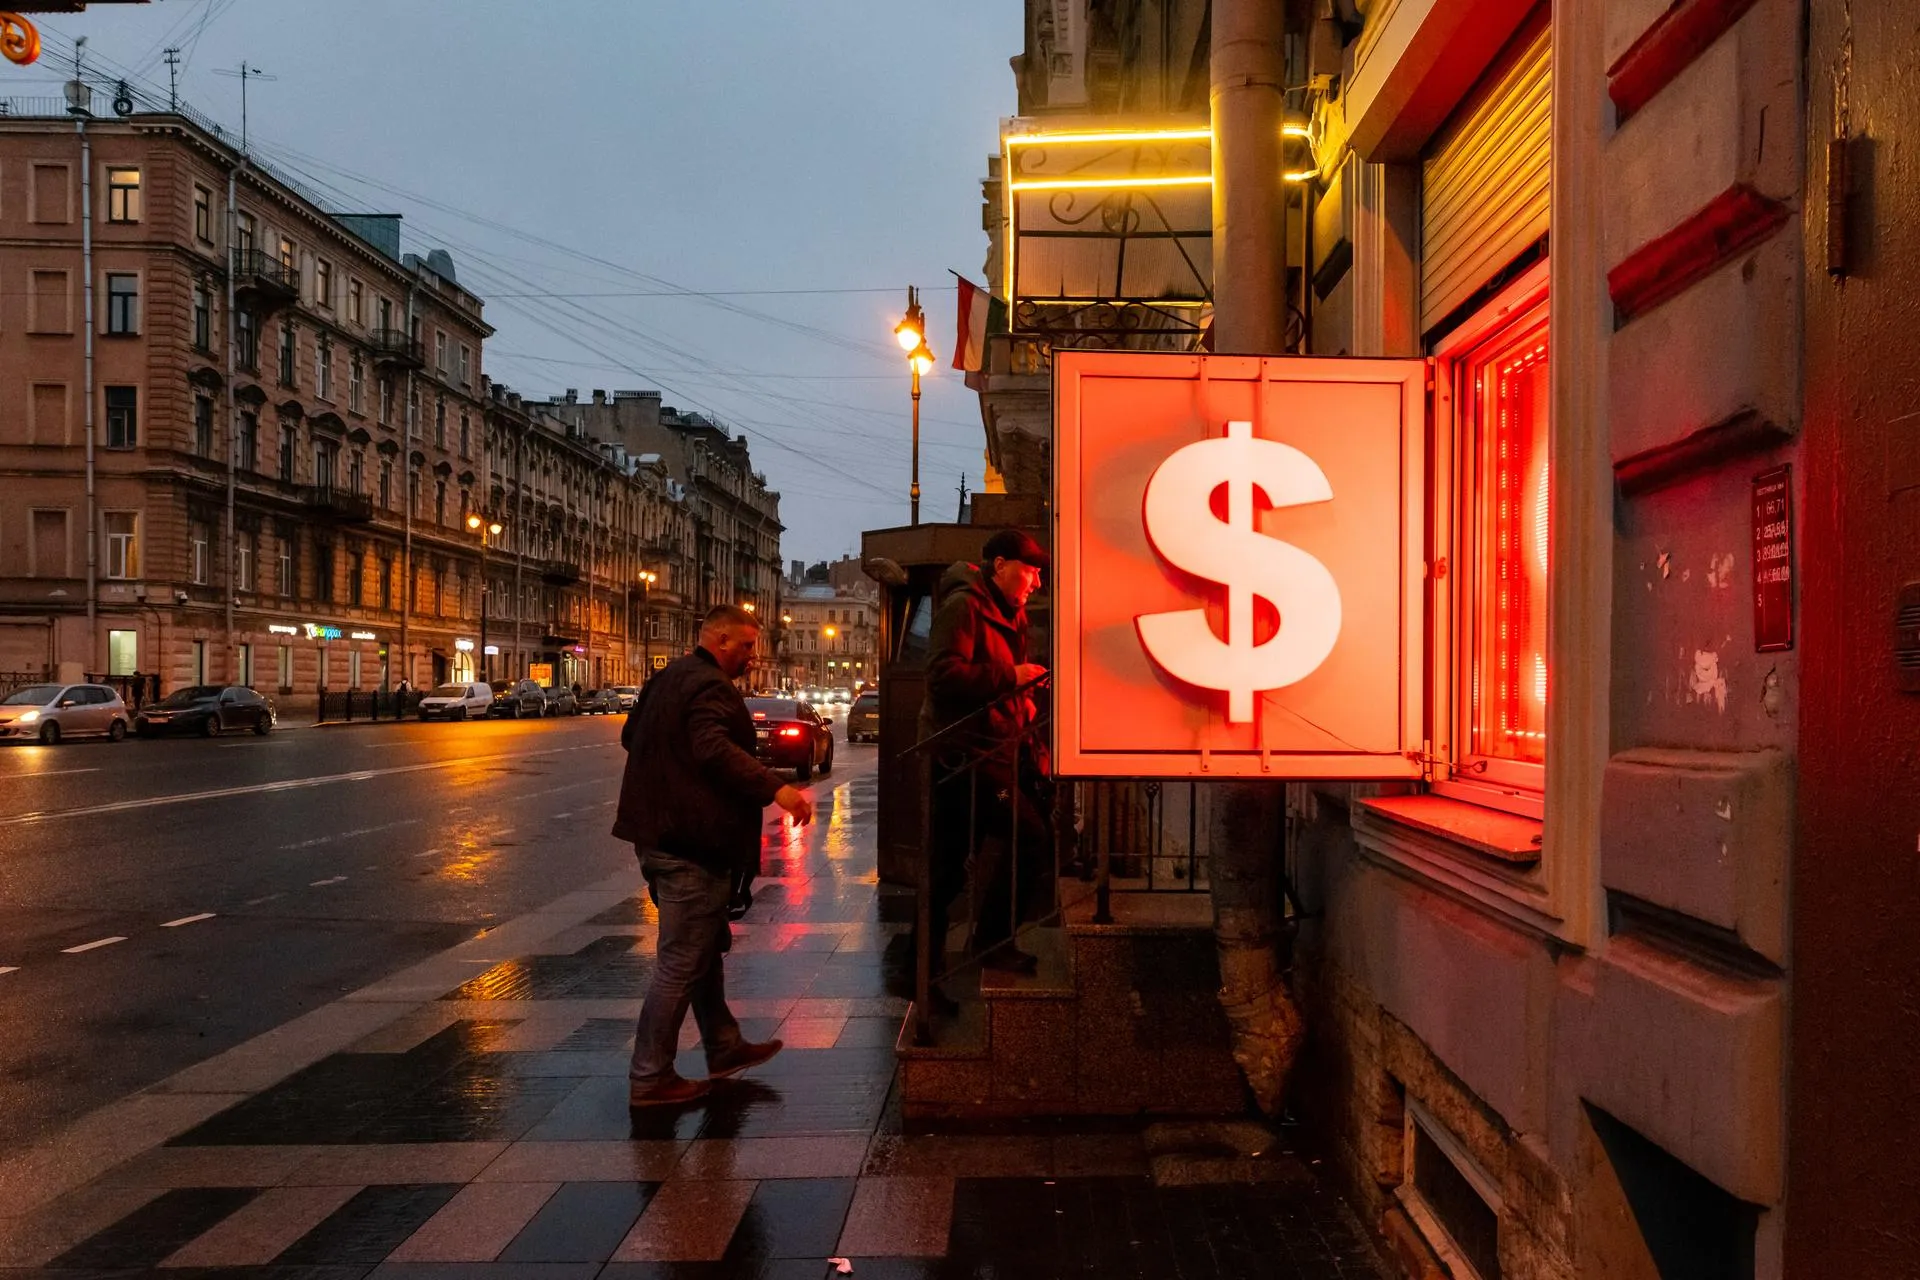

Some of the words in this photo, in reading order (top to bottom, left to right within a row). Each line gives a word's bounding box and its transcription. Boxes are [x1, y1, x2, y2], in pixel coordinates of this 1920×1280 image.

[1756, 527, 1761, 540] 2
[1756, 549, 1761, 563] 3
[1134, 420, 1342, 723] $
